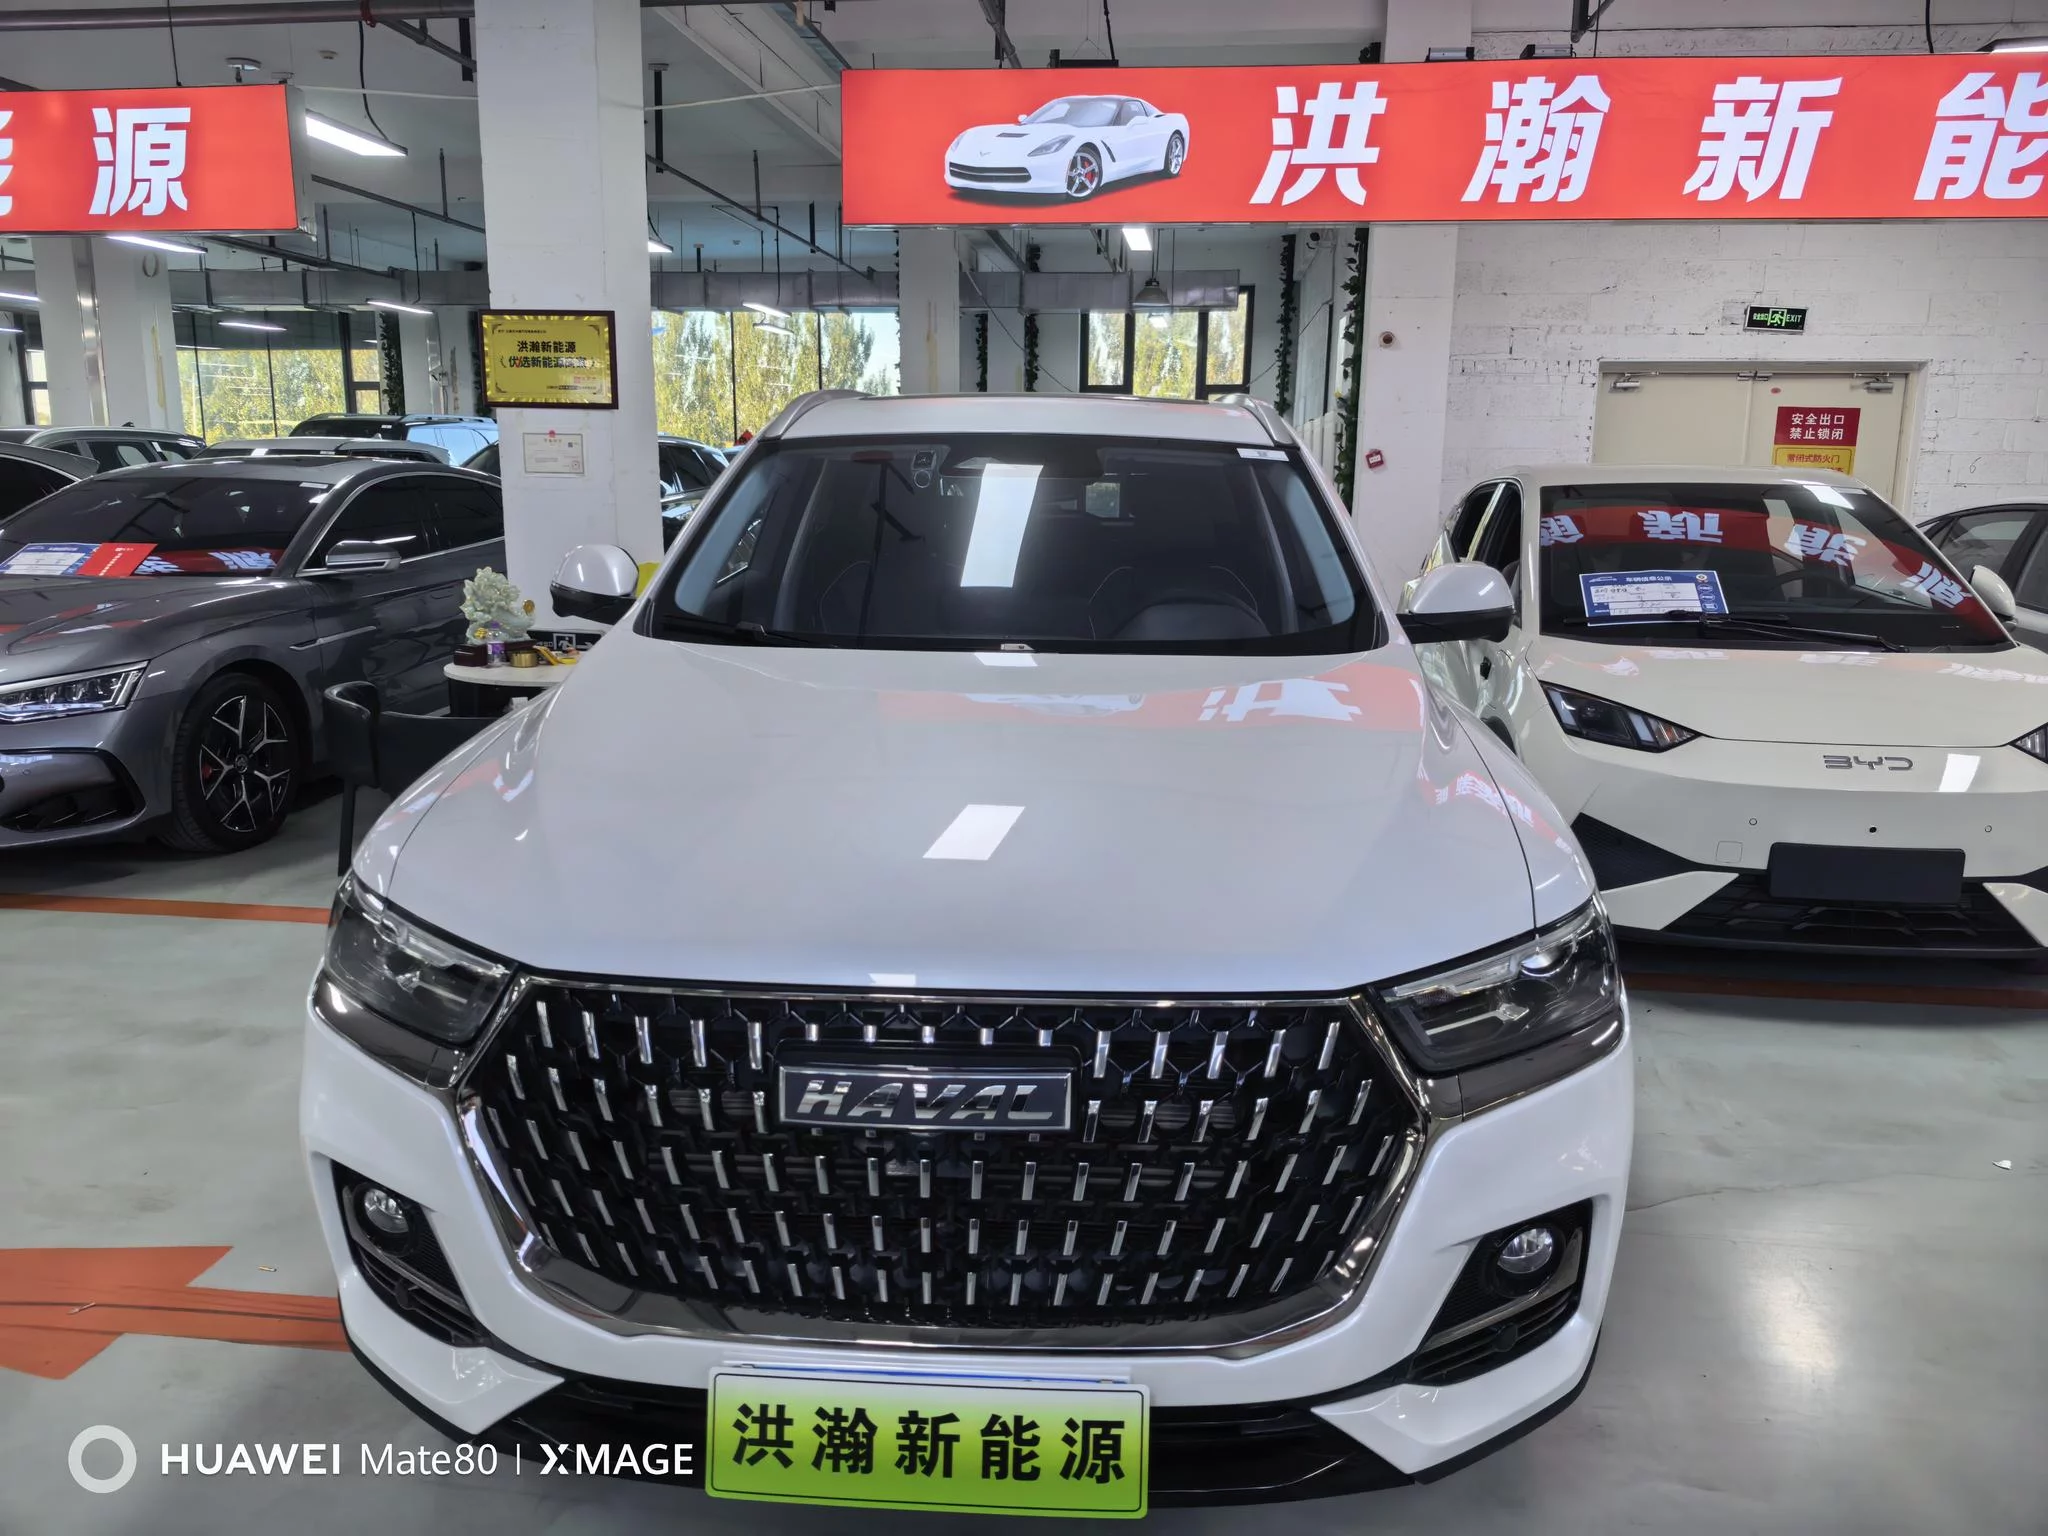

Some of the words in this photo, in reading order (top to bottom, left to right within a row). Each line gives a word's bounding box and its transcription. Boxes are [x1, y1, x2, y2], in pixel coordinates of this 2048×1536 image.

[1786, 314, 1802, 323] EXIT
[517, 341, 577, 353] 洪瀚新能源
[1791, 413, 1845, 425] 安全出口
[1789, 427, 1844, 440] 禁止锁闭
[1823, 755, 1914, 771] BYD
[797, 1080, 1053, 1120] HAVAL
[731, 1403, 1126, 1485] 洪瀚新能源
